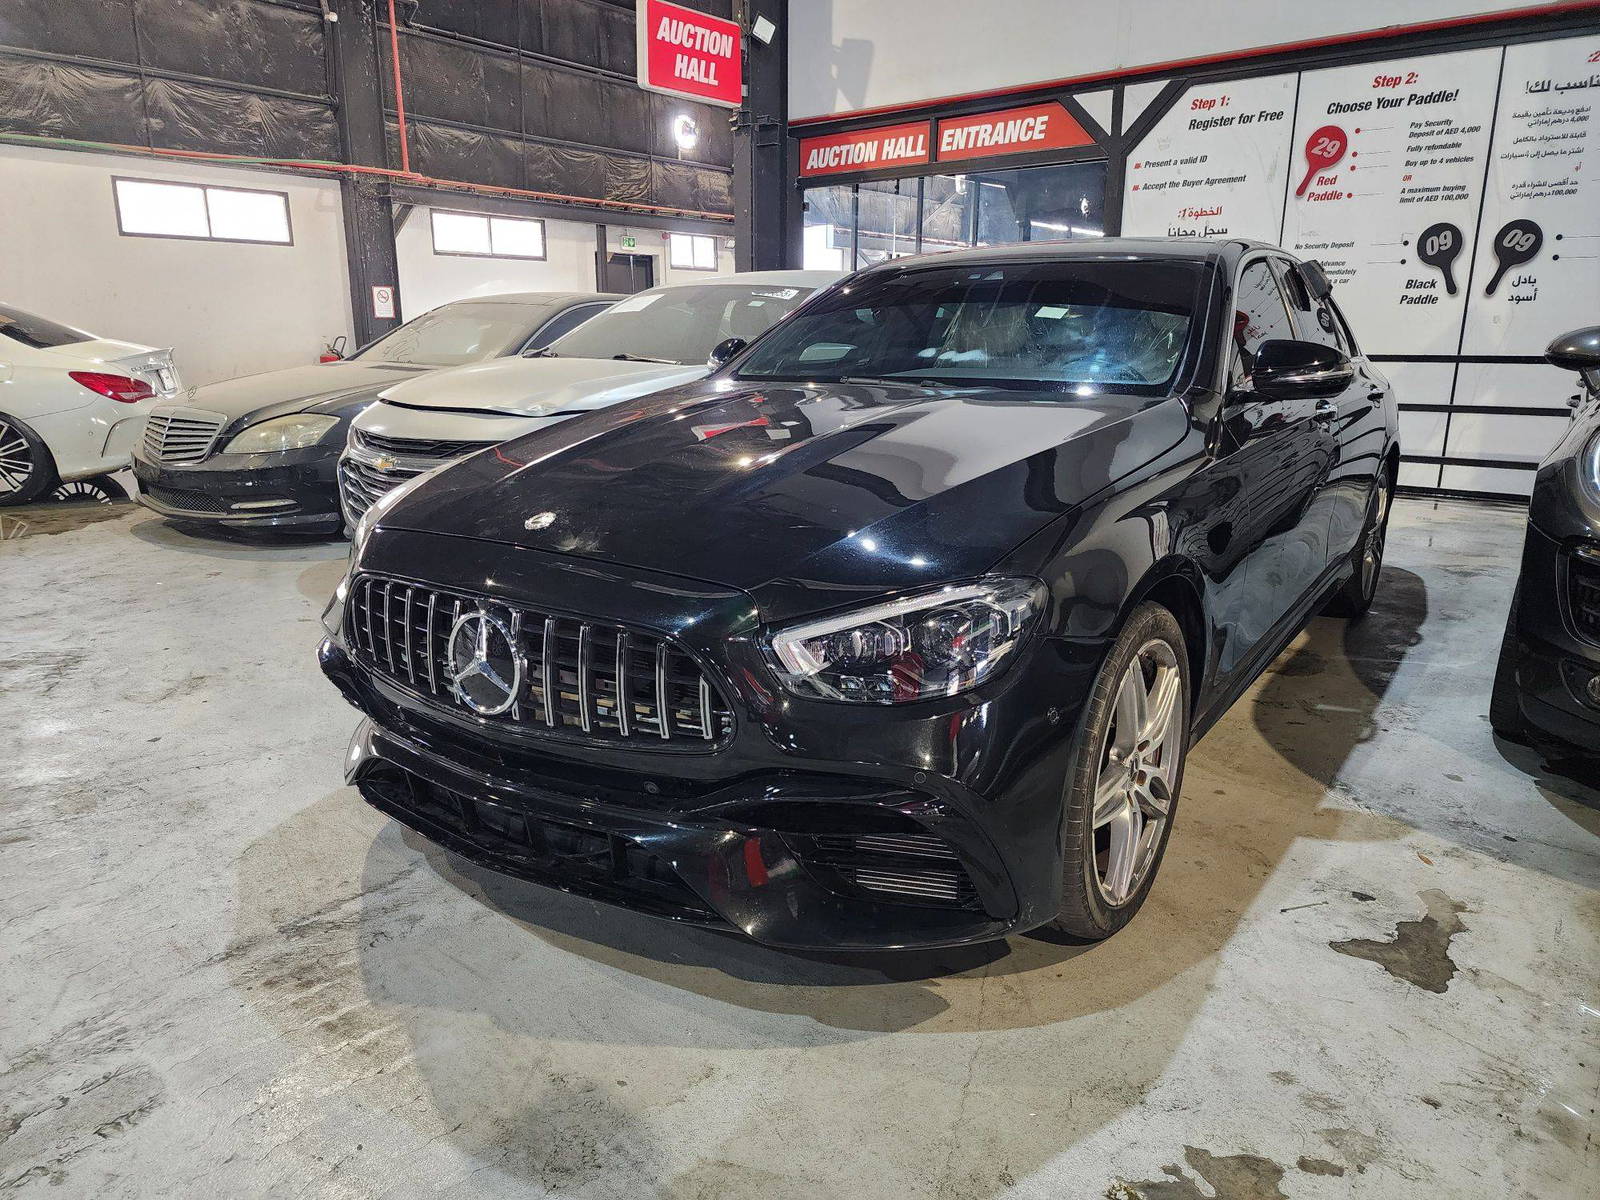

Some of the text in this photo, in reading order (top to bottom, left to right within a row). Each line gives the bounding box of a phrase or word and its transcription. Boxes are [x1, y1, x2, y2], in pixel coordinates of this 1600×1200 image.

[656, 16, 734, 58] AUCTION
[674, 54, 719, 86] HALL
[1372, 72, 1418, 88] Step 2:
[1190, 95, 1231, 111] Step 1:
[1327, 89, 1460, 114] Choose Your Paddle!
[1188, 110, 1284, 131] Register for Free
[1424, 119, 1453, 127] Security
[1408, 130, 1434, 139] Deposit
[1460, 126, 1481, 134] 4,000
[806, 116, 1049, 170] AUCTION HALL ENTRANCE
[1311, 137, 1340, 158] 29
[1424, 142, 1462, 151] refundable
[1144, 158, 1172, 168] Present
[1180, 156, 1198, 165] valid
[1199, 155, 1208, 163] ID
[1445, 156, 1474, 164] vehicles
[1142, 182, 1167, 191] Accept
[1182, 179, 1203, 189] Buyer
[1205, 174, 1247, 186] Agreement
[1316, 175, 1338, 186] Red
[1307, 190, 1343, 202] Paddle
[1330, 241, 1354, 249] Deposit
[1426, 230, 1452, 256] 09
[1502, 229, 1536, 252] 09
[1405, 279, 1438, 289] Black
[1512, 275, 1536, 287] بادل
[1400, 295, 1438, 304] Paddle
[1508, 288, 1538, 304] أسود
